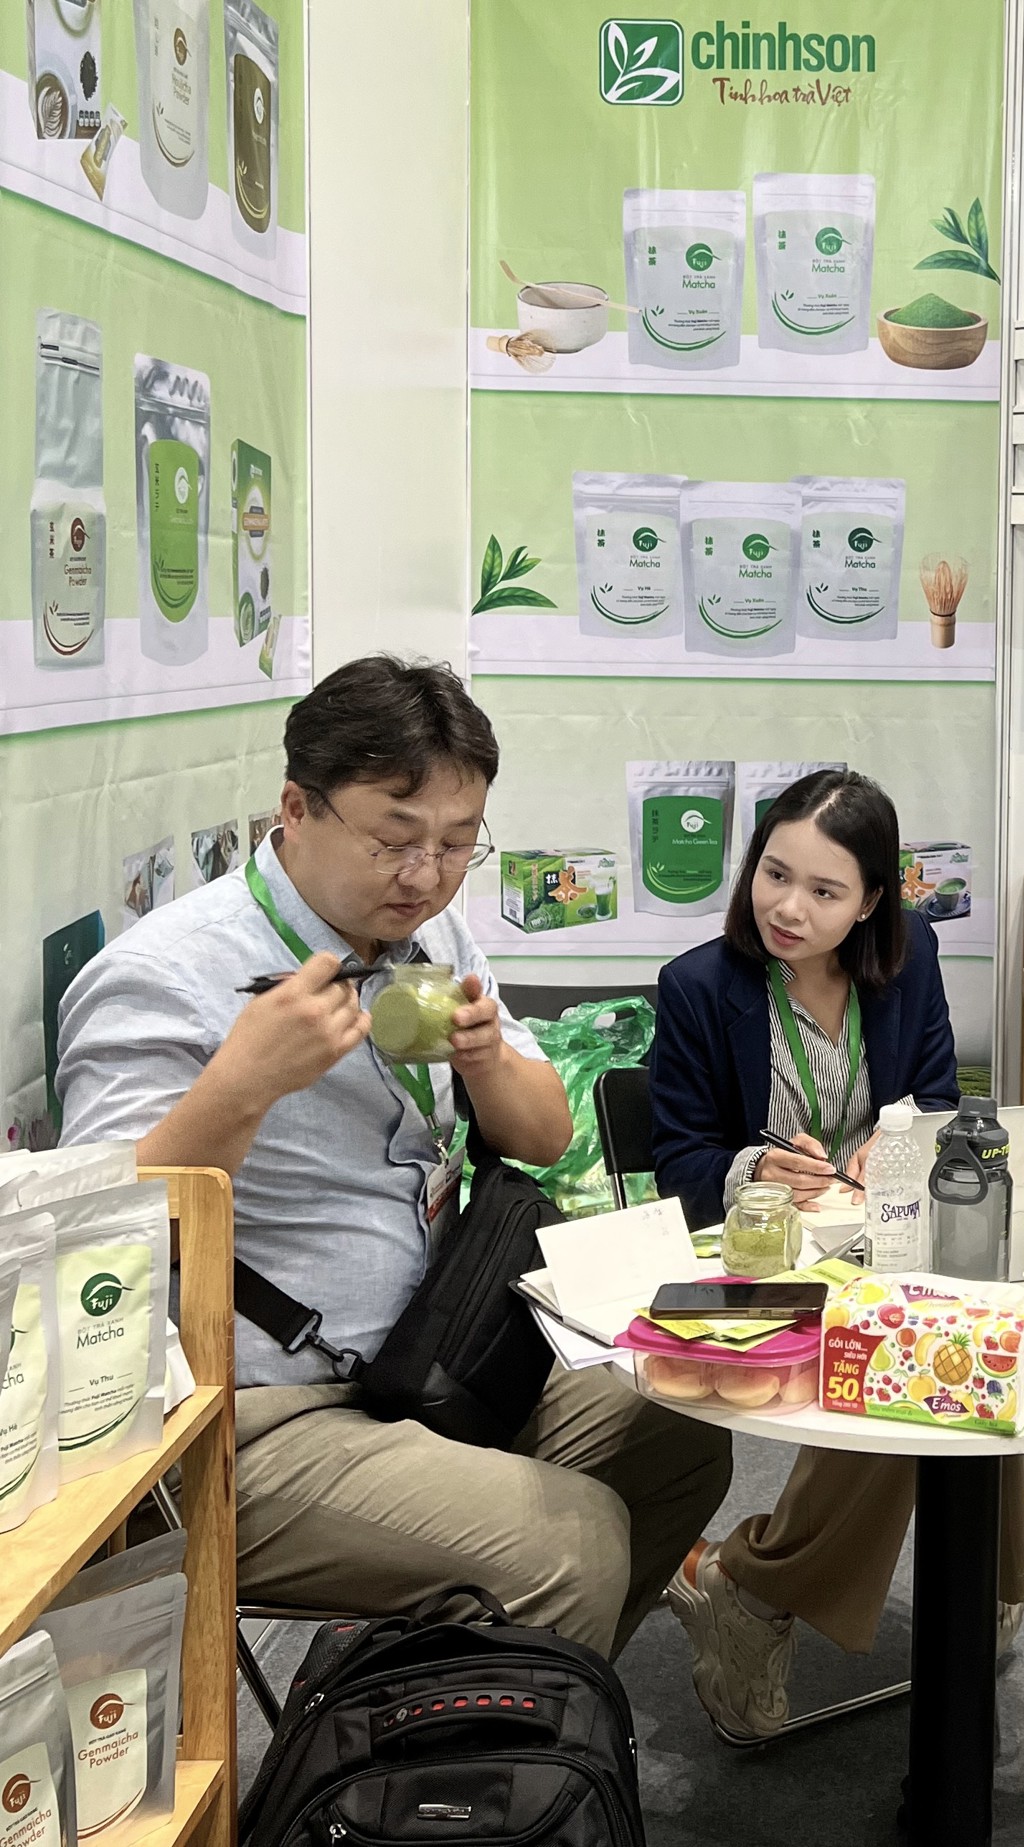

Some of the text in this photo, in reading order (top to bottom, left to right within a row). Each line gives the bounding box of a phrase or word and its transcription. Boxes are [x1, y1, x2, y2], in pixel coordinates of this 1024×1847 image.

[692, 21, 875, 72] chinhson
[712, 77, 758, 105] Tinh
[758, 79, 789, 105] hoa
[793, 82, 816, 106] trà
[812, 264, 845, 273] Matcha
[682, 280, 716, 289] Matcha
[630, 560, 660, 568] Matcha
[845, 560, 876, 568] Matcha
[739, 569, 772, 578] Matcha
[90, 1294, 113, 1311] Fuji
[76, 1326, 125, 1349] Matcha
[828, 1337, 844, 1349] GÓI
[833, 1359, 860, 1376] TẶNG
[1, 1372, 24, 1390] cha
[89, 1374, 114, 1388] Vụ Thu
[826, 1376, 860, 1401] 50
[932, 1398, 962, 1413] E'mos
[97, 1710, 118, 1725] Fuji
[77, 1731, 138, 1761] Genmaicha
[89, 1746, 129, 1769] Powder
[9, 1791, 26, 1808] Fuji
[11, 1826, 45, 1847] owder
